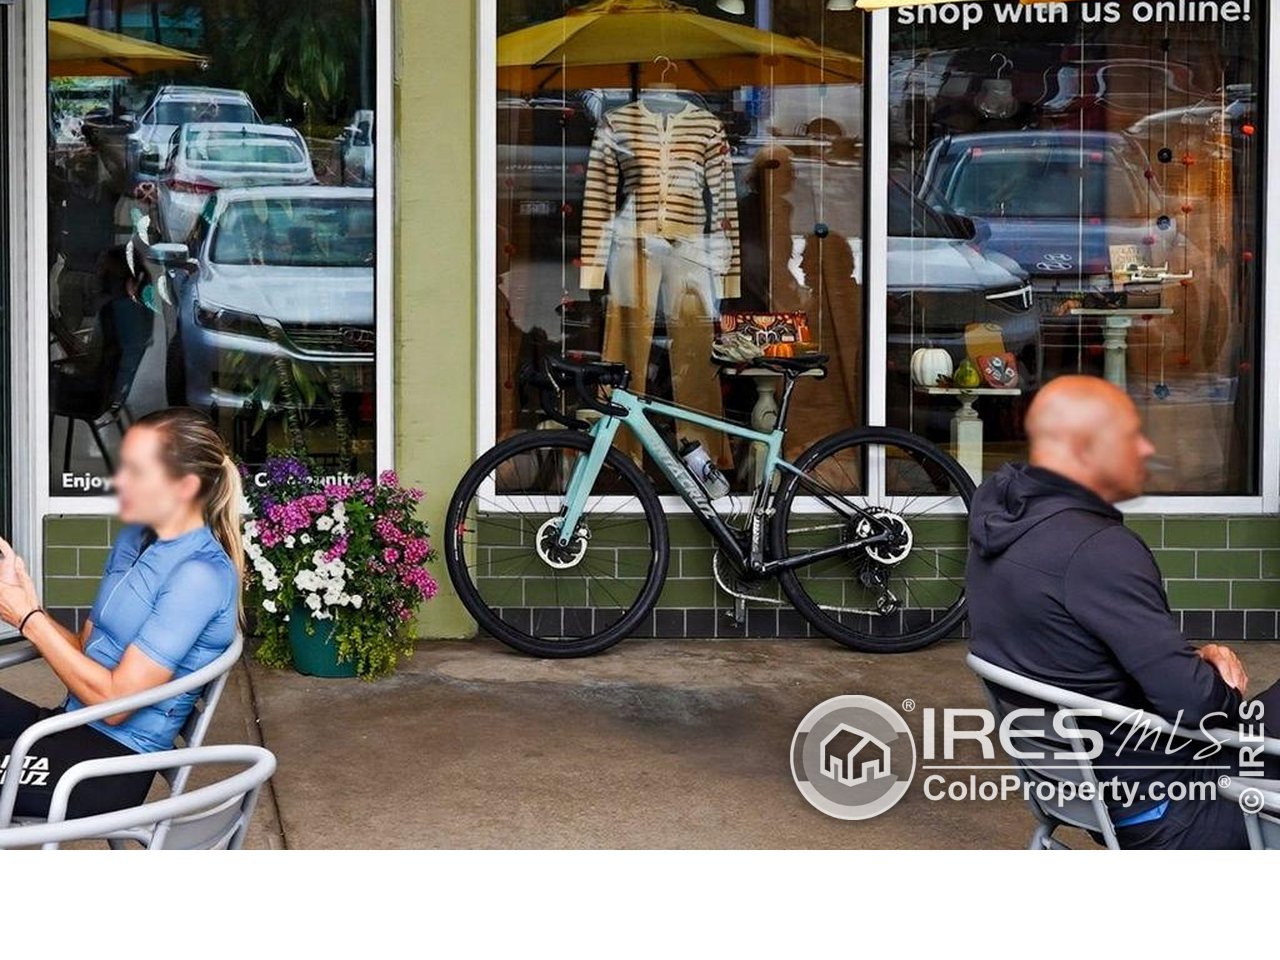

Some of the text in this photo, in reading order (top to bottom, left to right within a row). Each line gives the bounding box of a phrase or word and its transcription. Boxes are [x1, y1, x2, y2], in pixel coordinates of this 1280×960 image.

[897, 3, 984, 30] shop
[993, 1, 1069, 24] with
[1082, 1, 1121, 23] us
